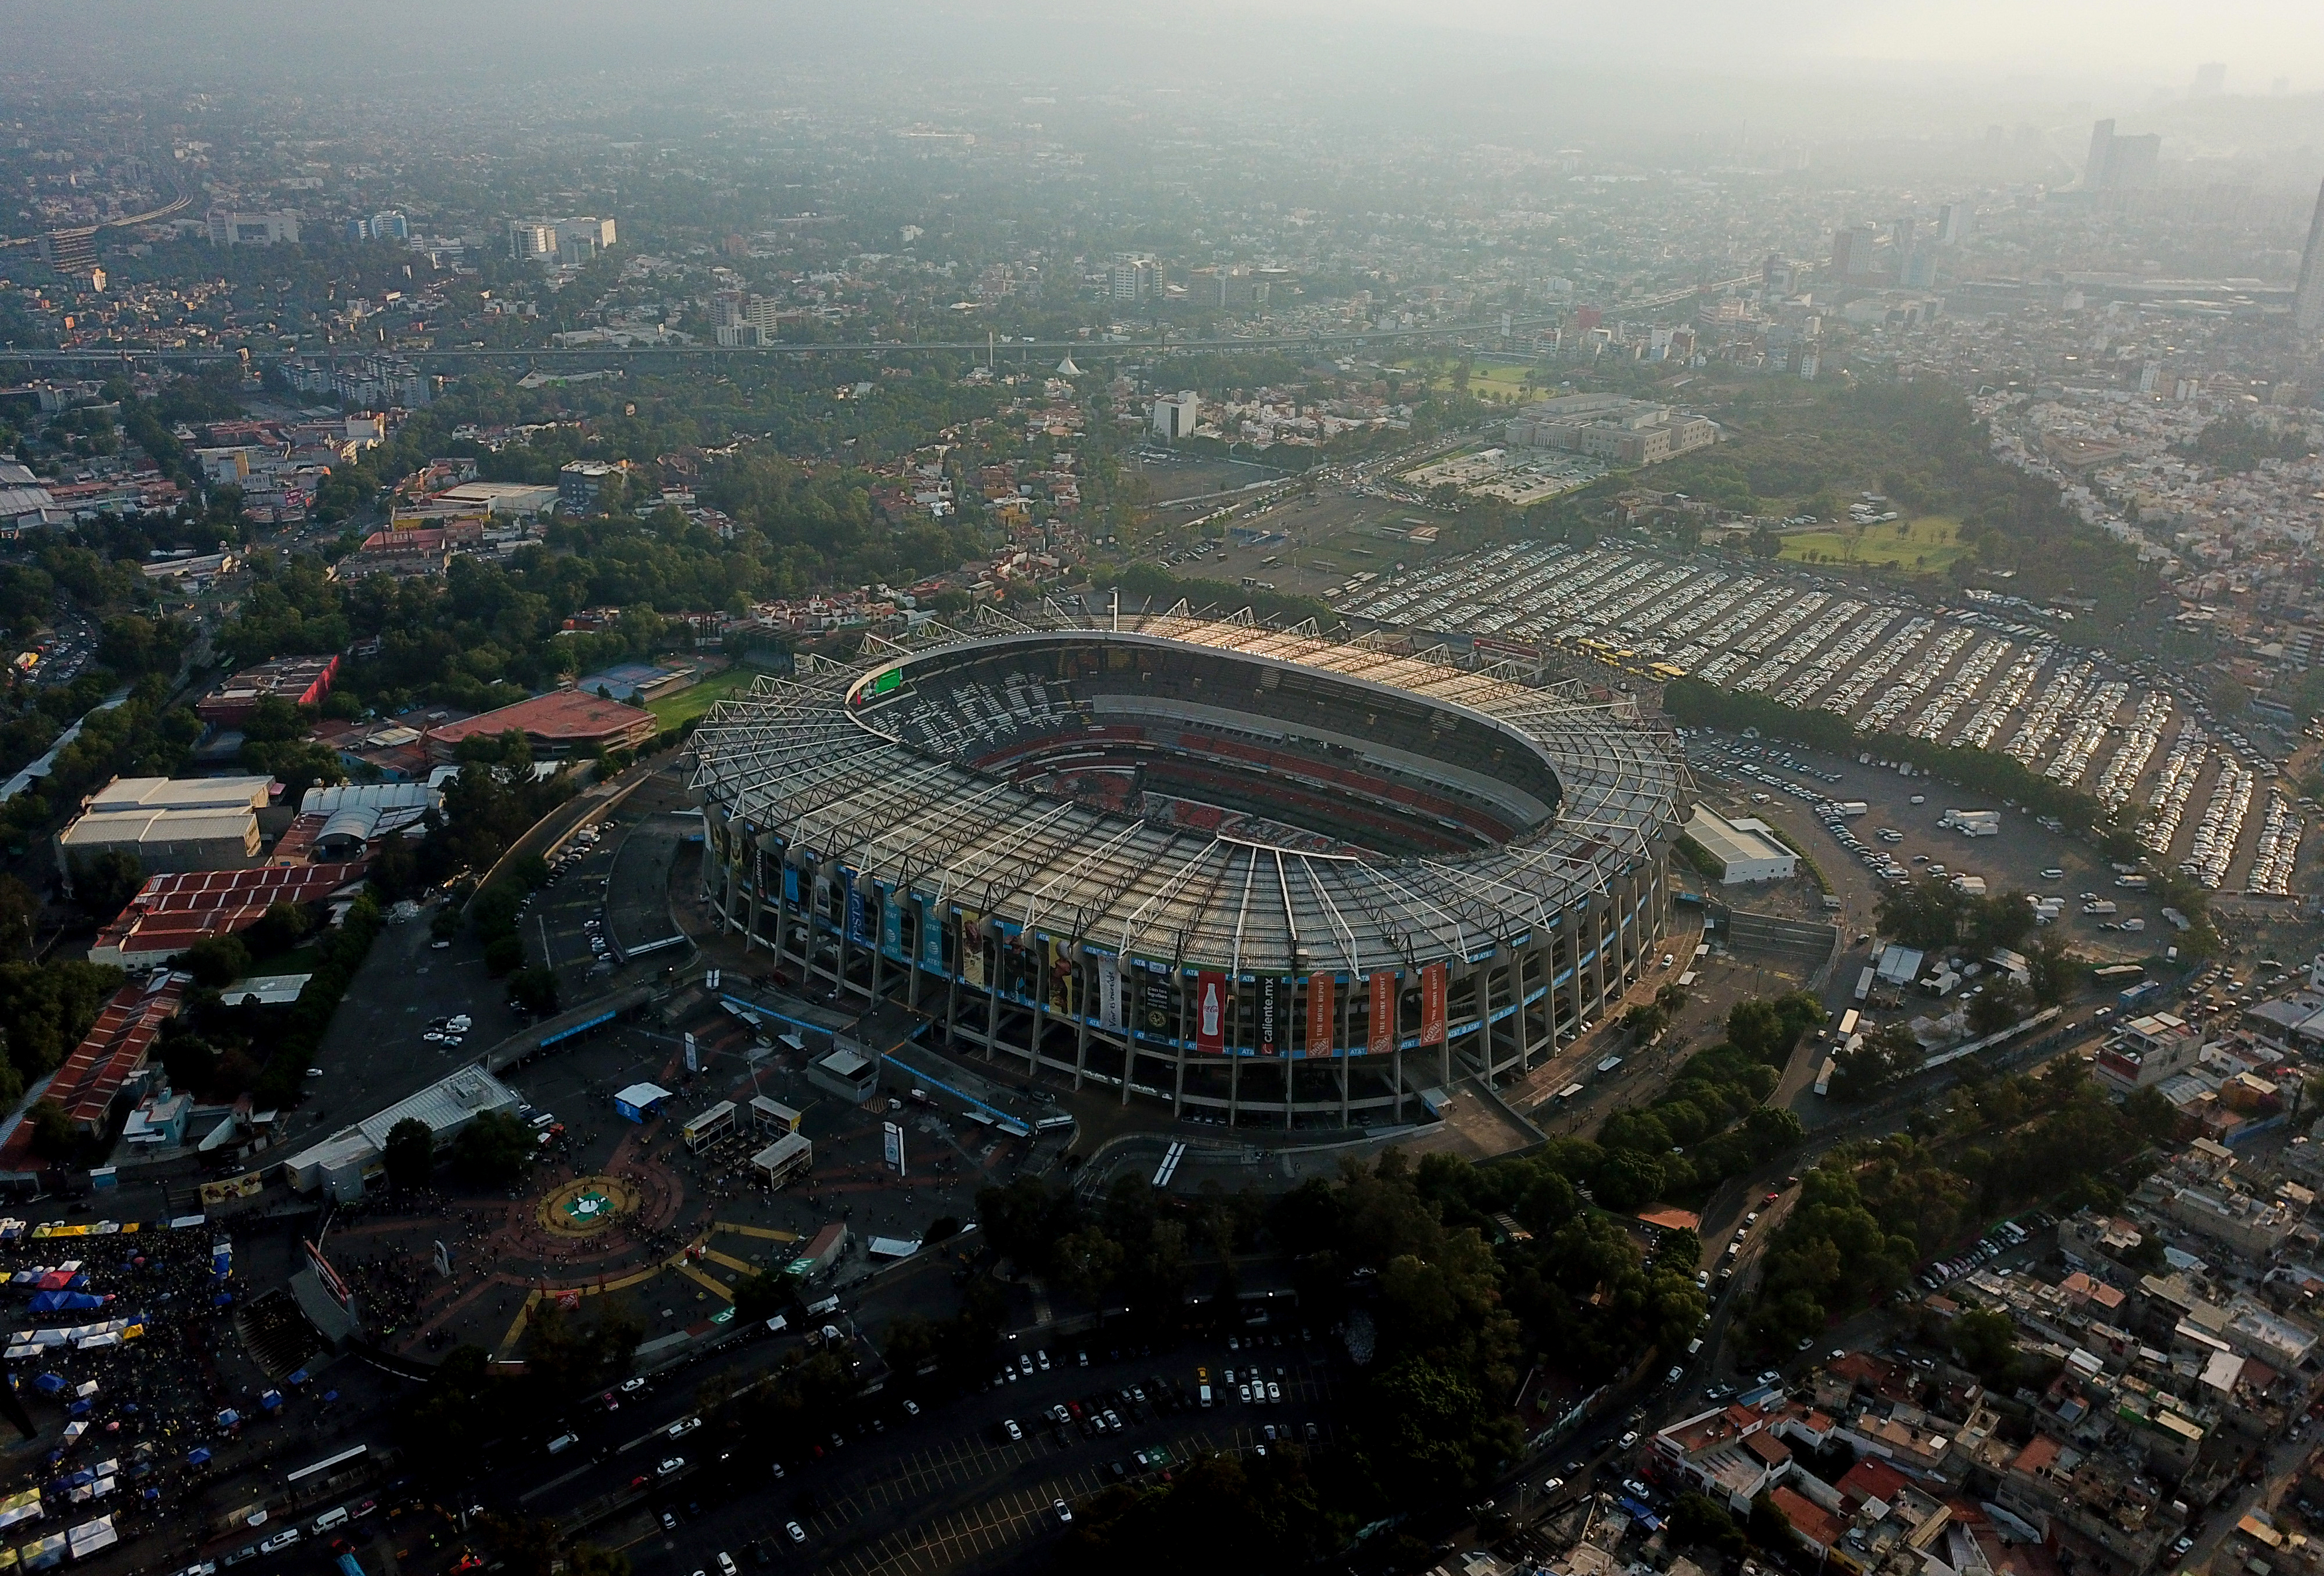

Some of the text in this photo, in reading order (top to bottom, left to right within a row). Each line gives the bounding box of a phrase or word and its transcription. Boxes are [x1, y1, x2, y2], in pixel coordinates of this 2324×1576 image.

[1517, 934, 1529, 945] AT&T
[1479, 950, 1493, 960] AT&T
[1262, 977, 1274, 1043] caliente.mx
[1467, 1022, 1480, 1032] AT&T
